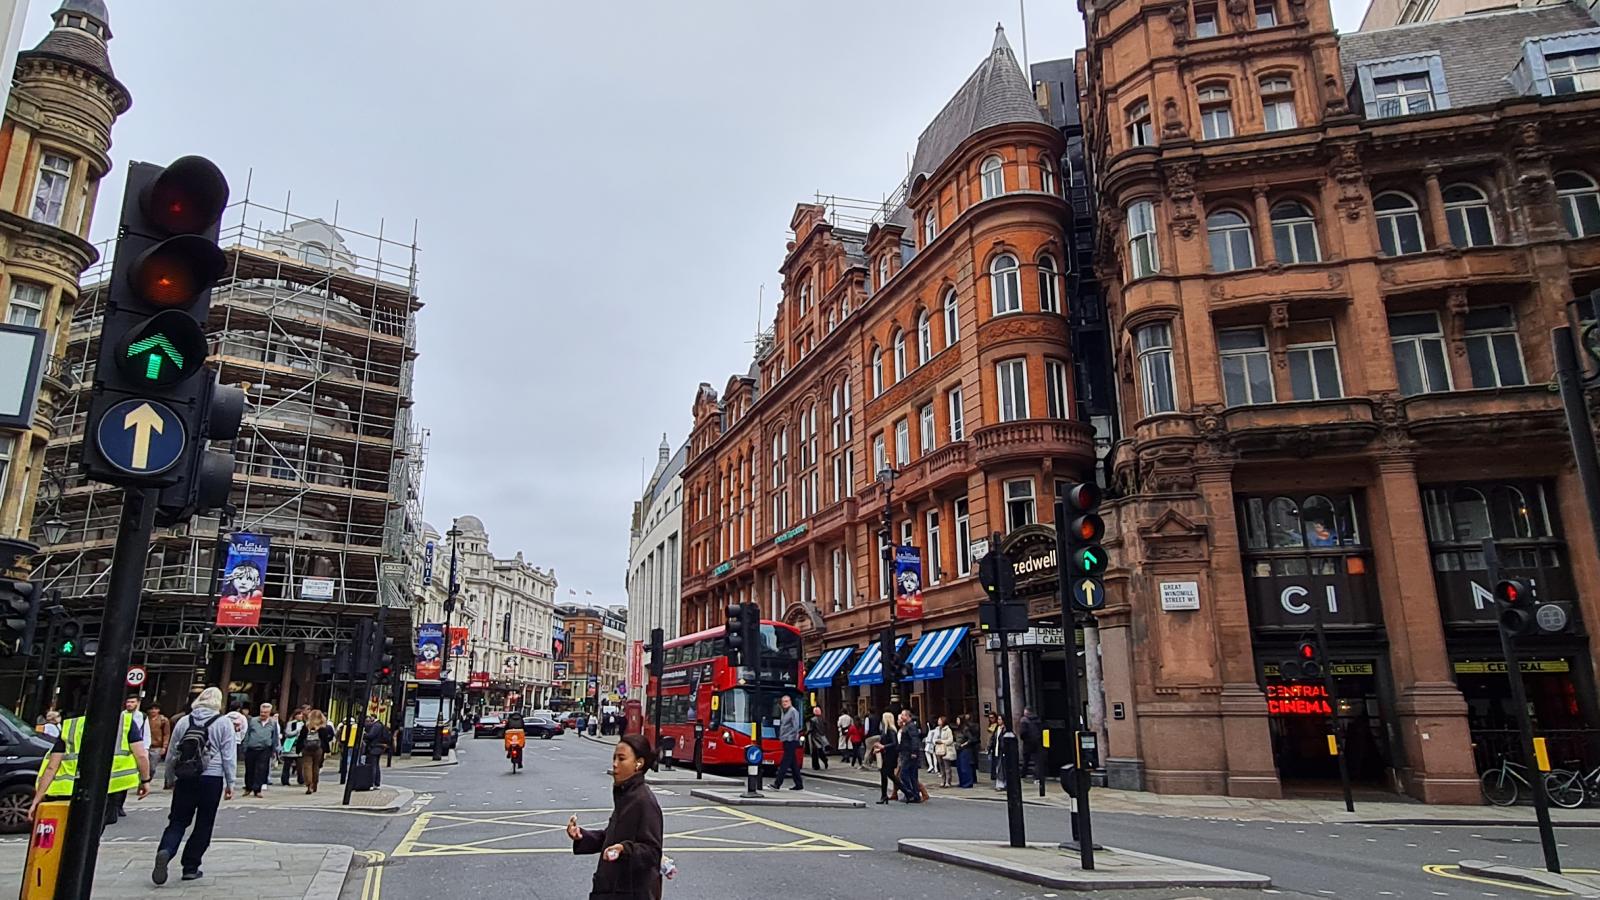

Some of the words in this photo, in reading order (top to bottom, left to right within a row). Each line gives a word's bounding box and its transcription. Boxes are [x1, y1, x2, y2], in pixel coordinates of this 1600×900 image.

[423, 548, 432, 584] LYRIC
[1012, 549, 1057, 575] zedwell
[1037, 627, 1063, 635] CINEM
[1043, 635, 1064, 644] CAFE
[1487, 661, 1544, 673] CERAL
[128, 671, 144, 681] 20
[779, 671, 791, 681] 14
[1266, 685, 1329, 697] CENTRAL
[1268, 699, 1333, 714] CINEMA
